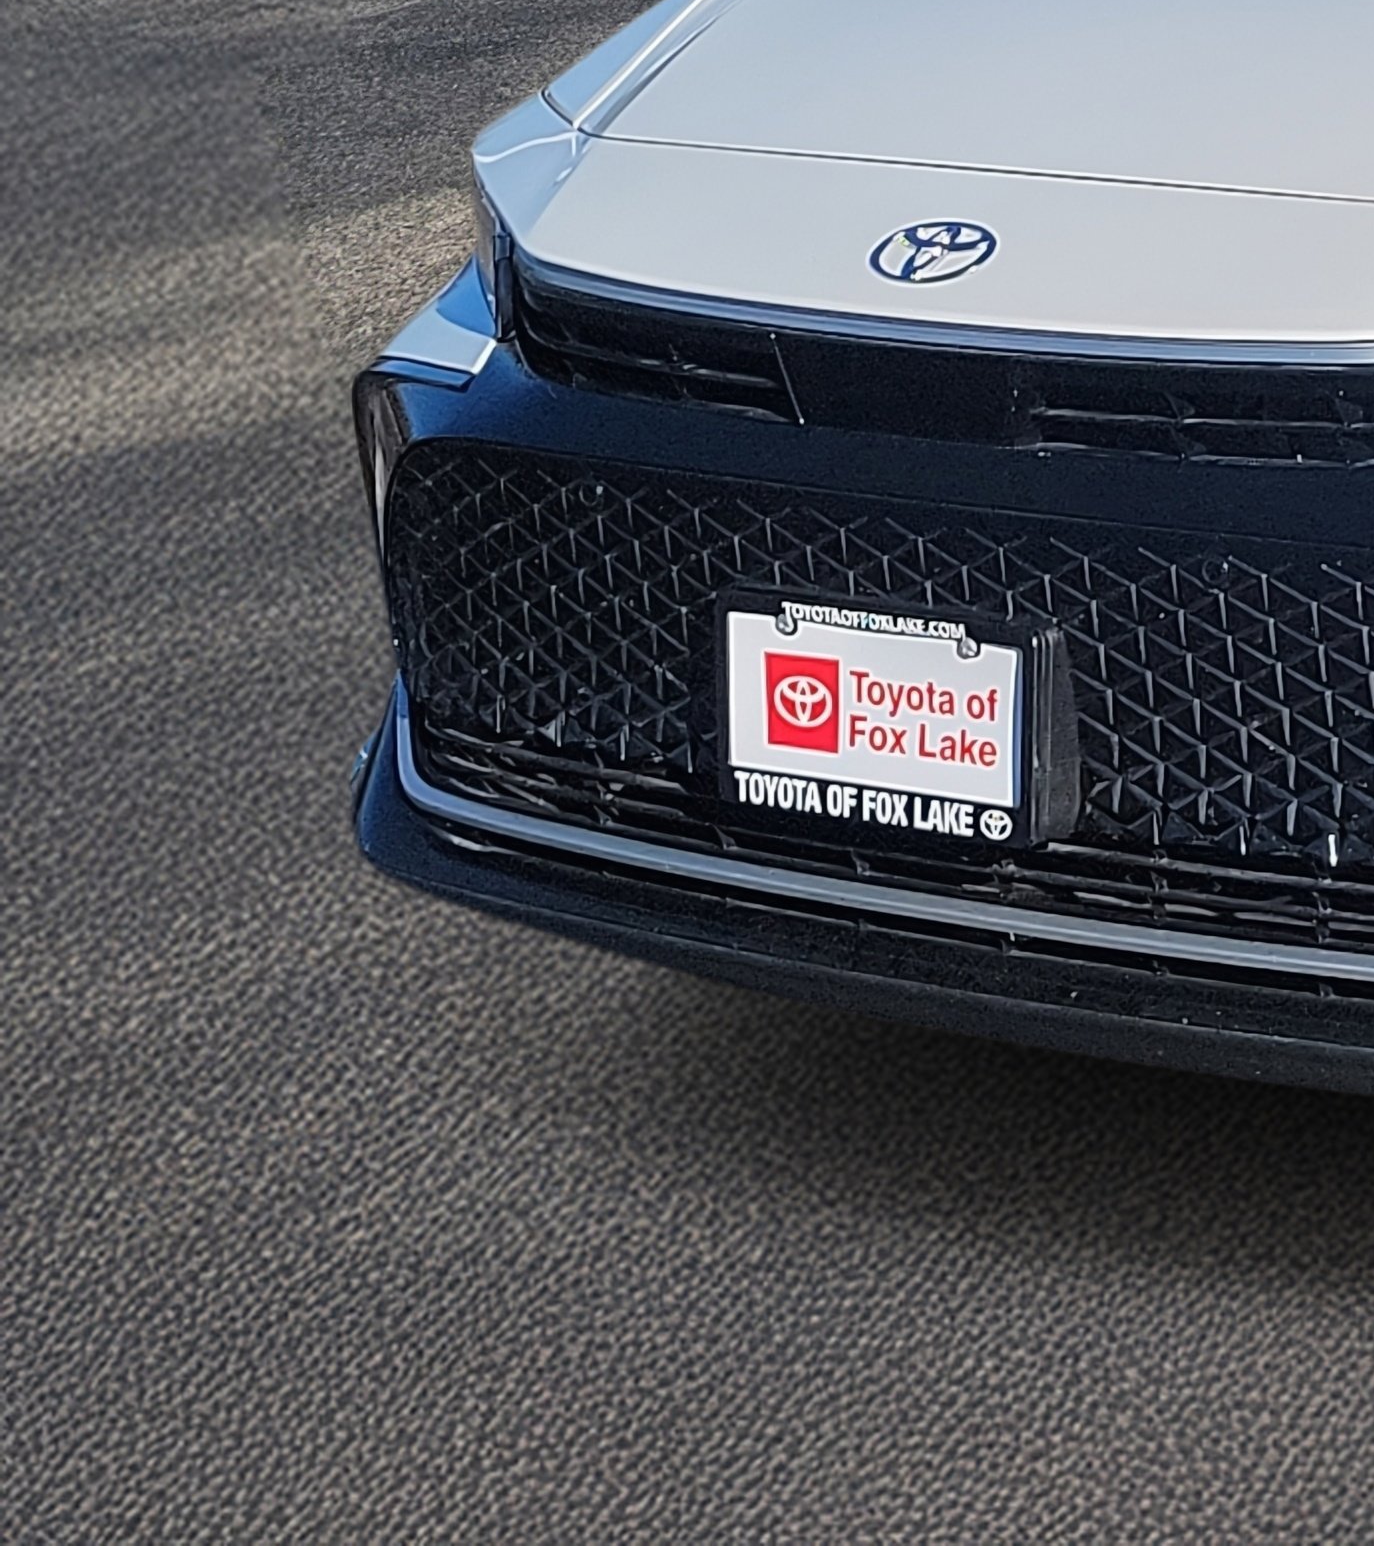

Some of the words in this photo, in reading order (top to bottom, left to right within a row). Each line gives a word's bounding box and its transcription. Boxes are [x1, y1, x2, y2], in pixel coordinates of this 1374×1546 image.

[781, 601, 967, 640] TOYOTAOFFOXLAKE.COM
[849, 669, 956, 718] Toyota
[966, 688, 998, 722] of
[848, 714, 908, 756] Fox
[917, 723, 998, 768] Lake
[733, 769, 823, 815] TOYOTA
[826, 783, 858, 819] OF
[861, 789, 909, 829] FOX
[912, 796, 976, 838] LAKE
